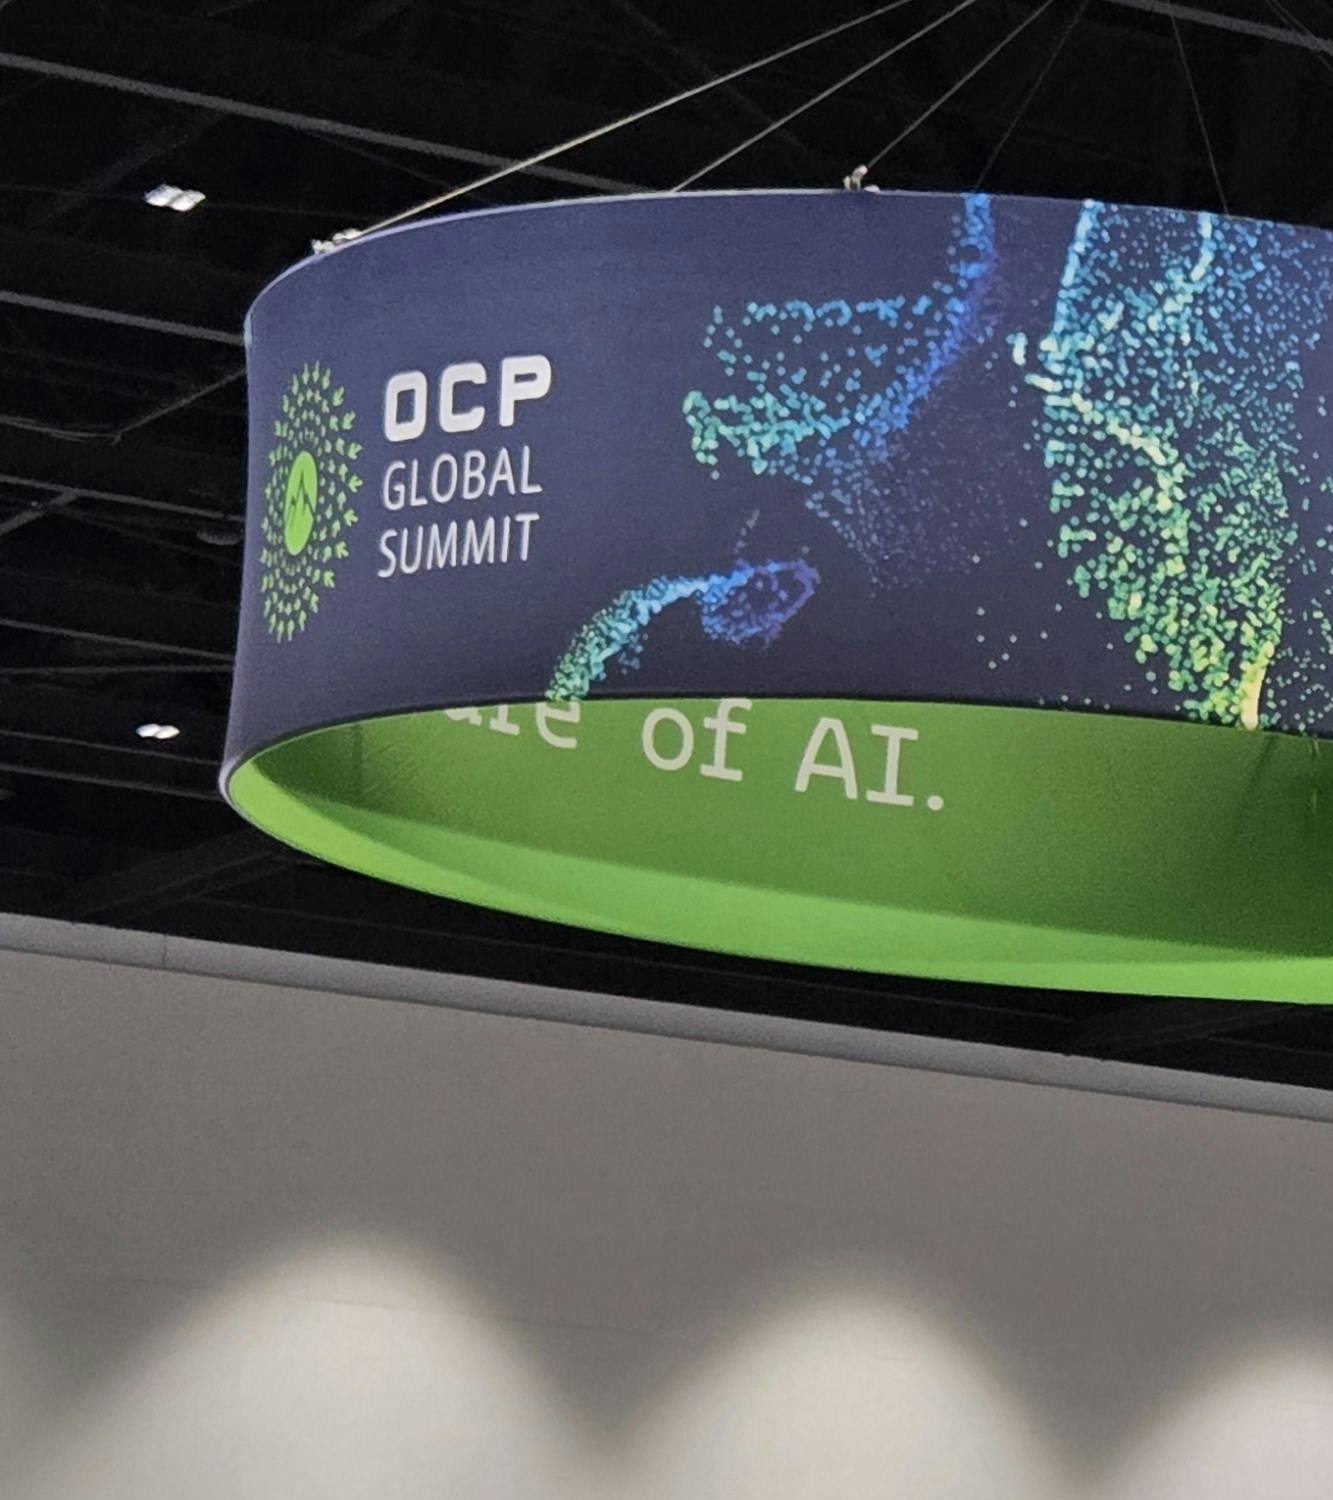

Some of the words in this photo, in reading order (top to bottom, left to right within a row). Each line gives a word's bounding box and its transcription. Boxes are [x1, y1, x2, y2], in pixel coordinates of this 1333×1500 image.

[383, 355, 552, 442] OCP
[382, 446, 542, 510] GLOBAL
[377, 512, 540, 578] SUMMIT
[641, 697, 753, 782] of
[794, 717, 944, 812] AI.
